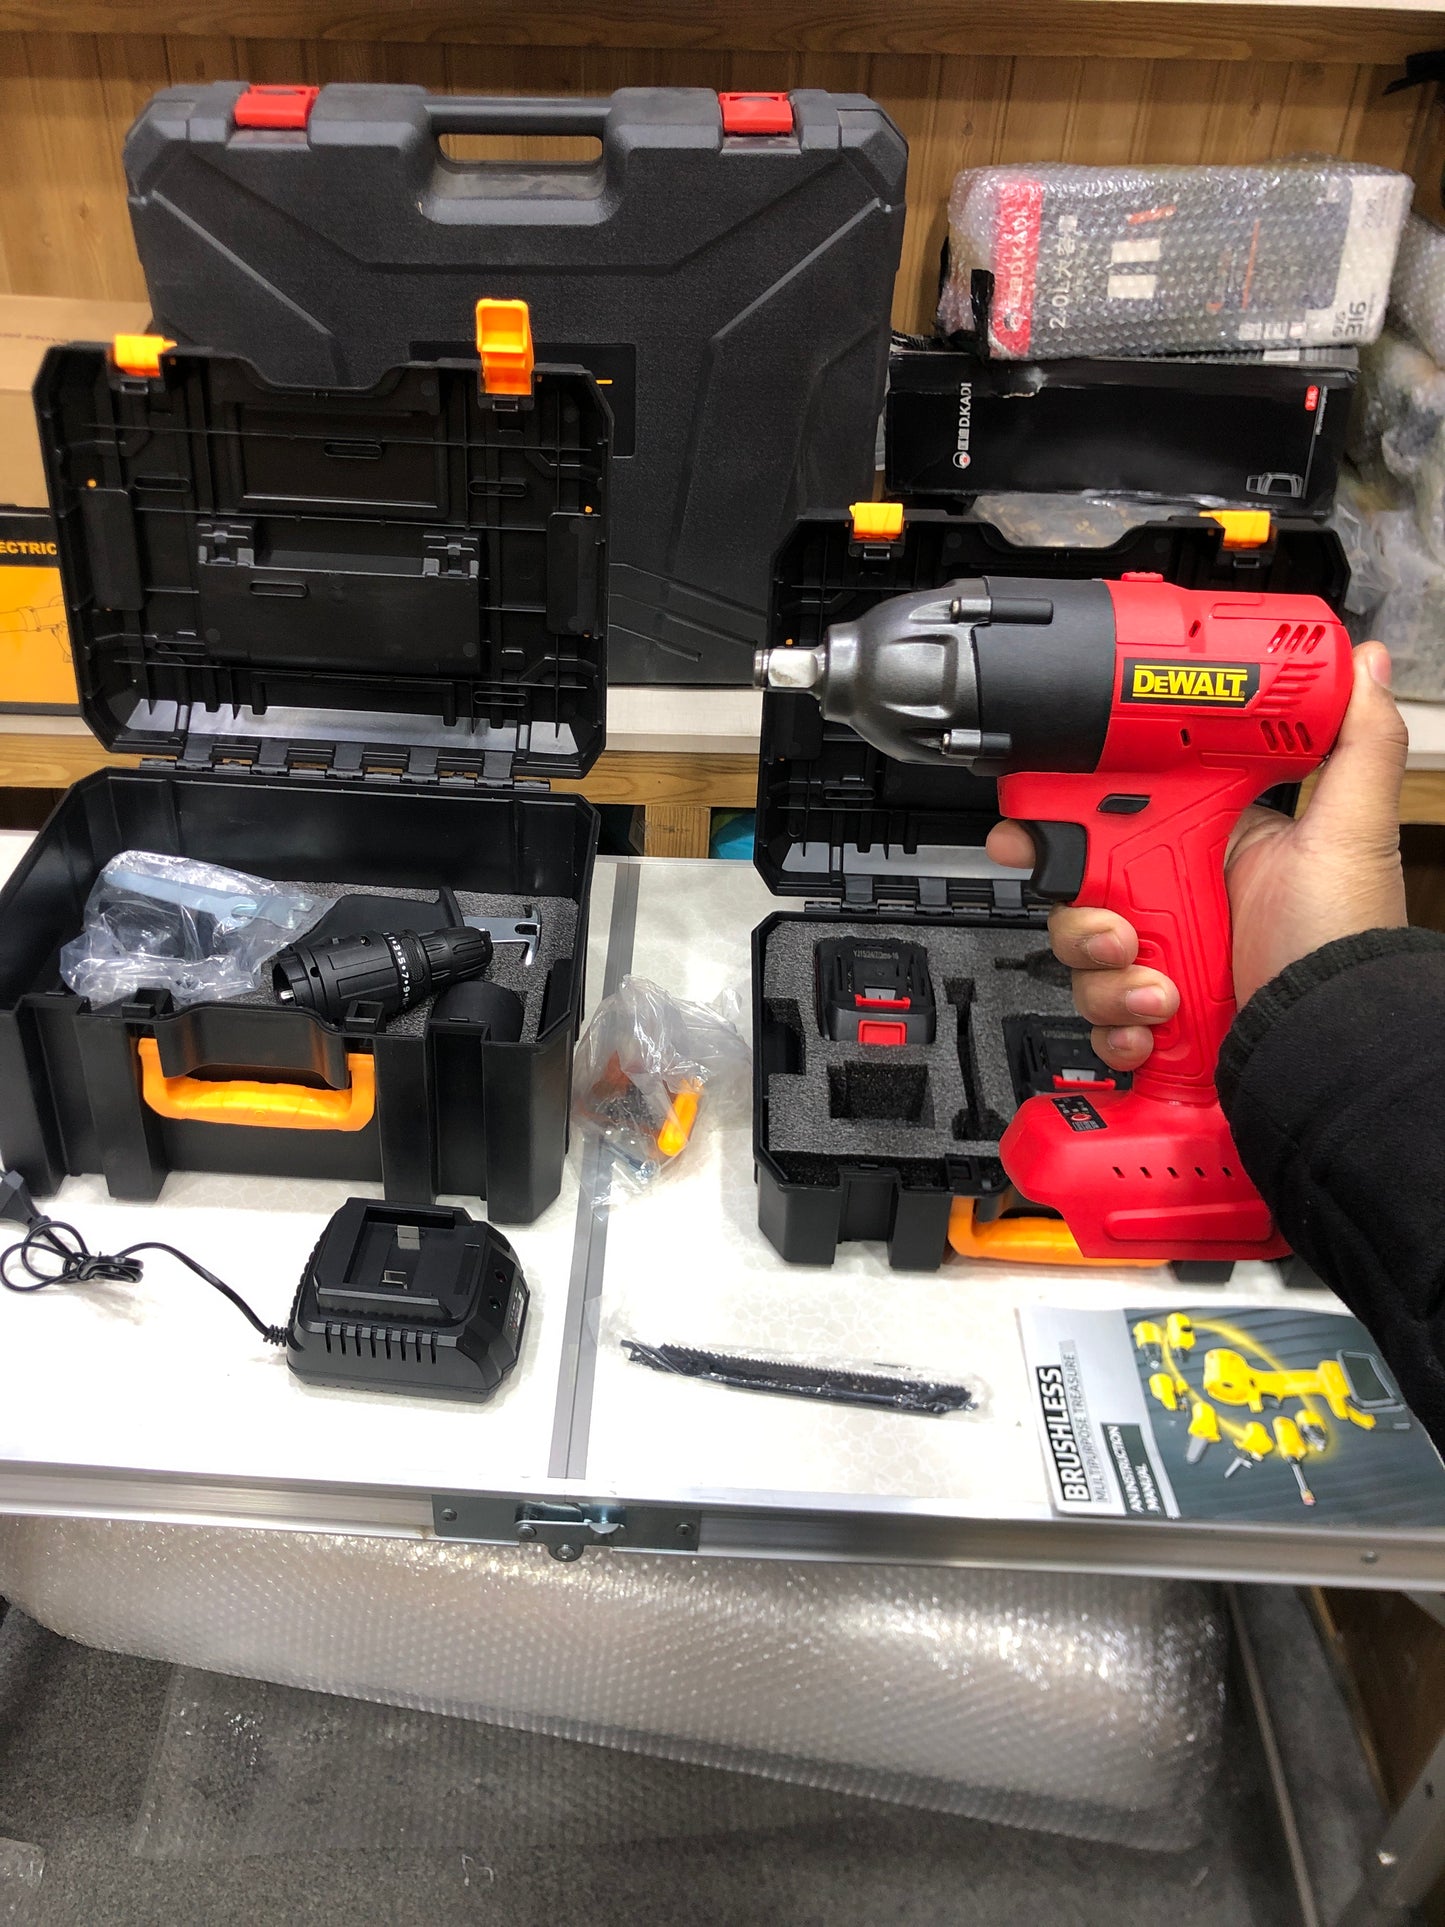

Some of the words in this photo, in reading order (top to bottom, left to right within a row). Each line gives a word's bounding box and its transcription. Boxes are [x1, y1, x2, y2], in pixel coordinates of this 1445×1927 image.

[1344, 301, 1367, 337] 316
[958, 382, 972, 427] D.KADI
[0, 541, 57, 555] ECTRIC
[1063, 1353, 1083, 1414] TREASURE
[1038, 1367, 1090, 1501] BRUSHLESS
[1076, 1416, 1107, 1502] MULTIPURPOSE
[1108, 1425, 1139, 1497] INSTRUCTION
[1135, 1463, 1161, 1513] MANUAL
